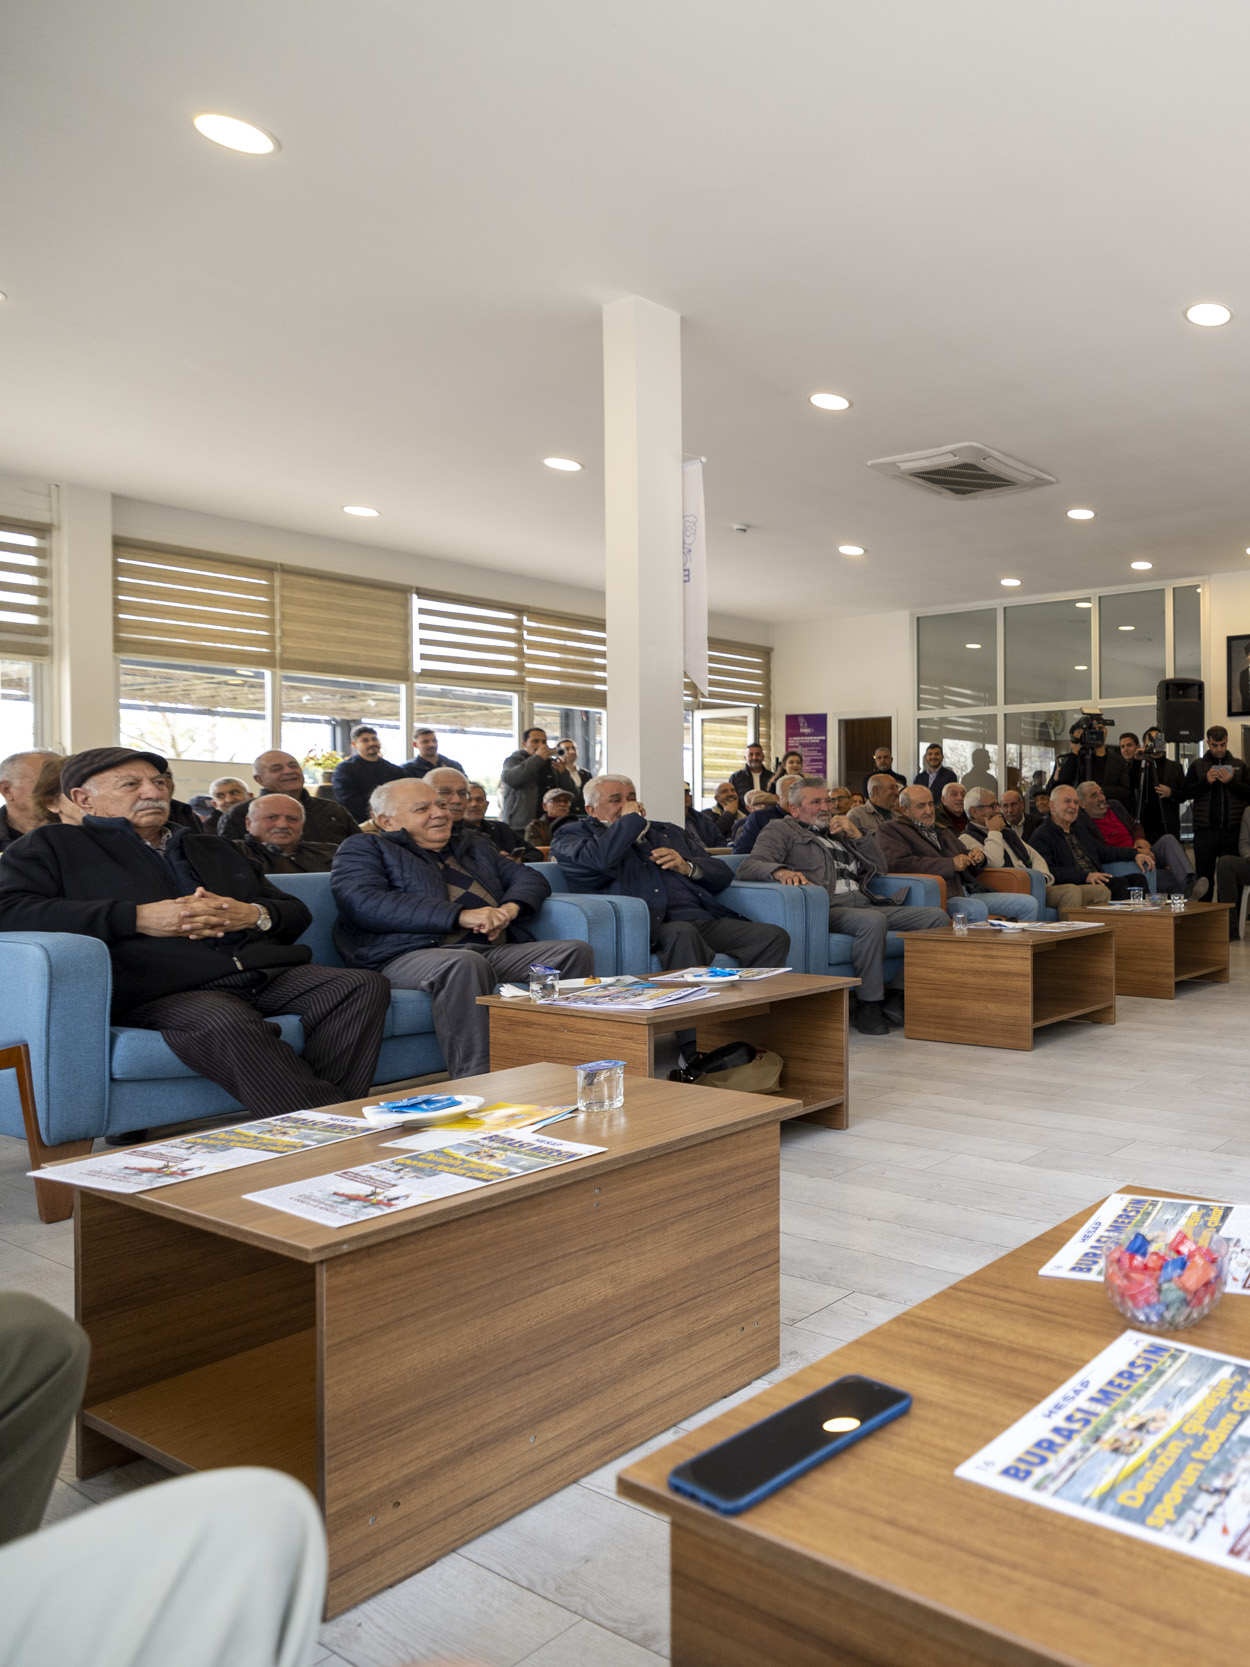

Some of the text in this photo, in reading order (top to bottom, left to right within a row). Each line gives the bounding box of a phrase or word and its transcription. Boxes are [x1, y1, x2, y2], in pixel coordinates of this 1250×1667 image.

[1079, 1220, 1103, 1244] HESAP
[1043, 1379, 1091, 1419] HESAP
[998, 1406, 1101, 1482] BURASI
[1116, 1374, 1242, 1508] Denizin, güneşin,
[1145, 1461, 1206, 1528] sporun
[1190, 1411, 1242, 1461] tadını
